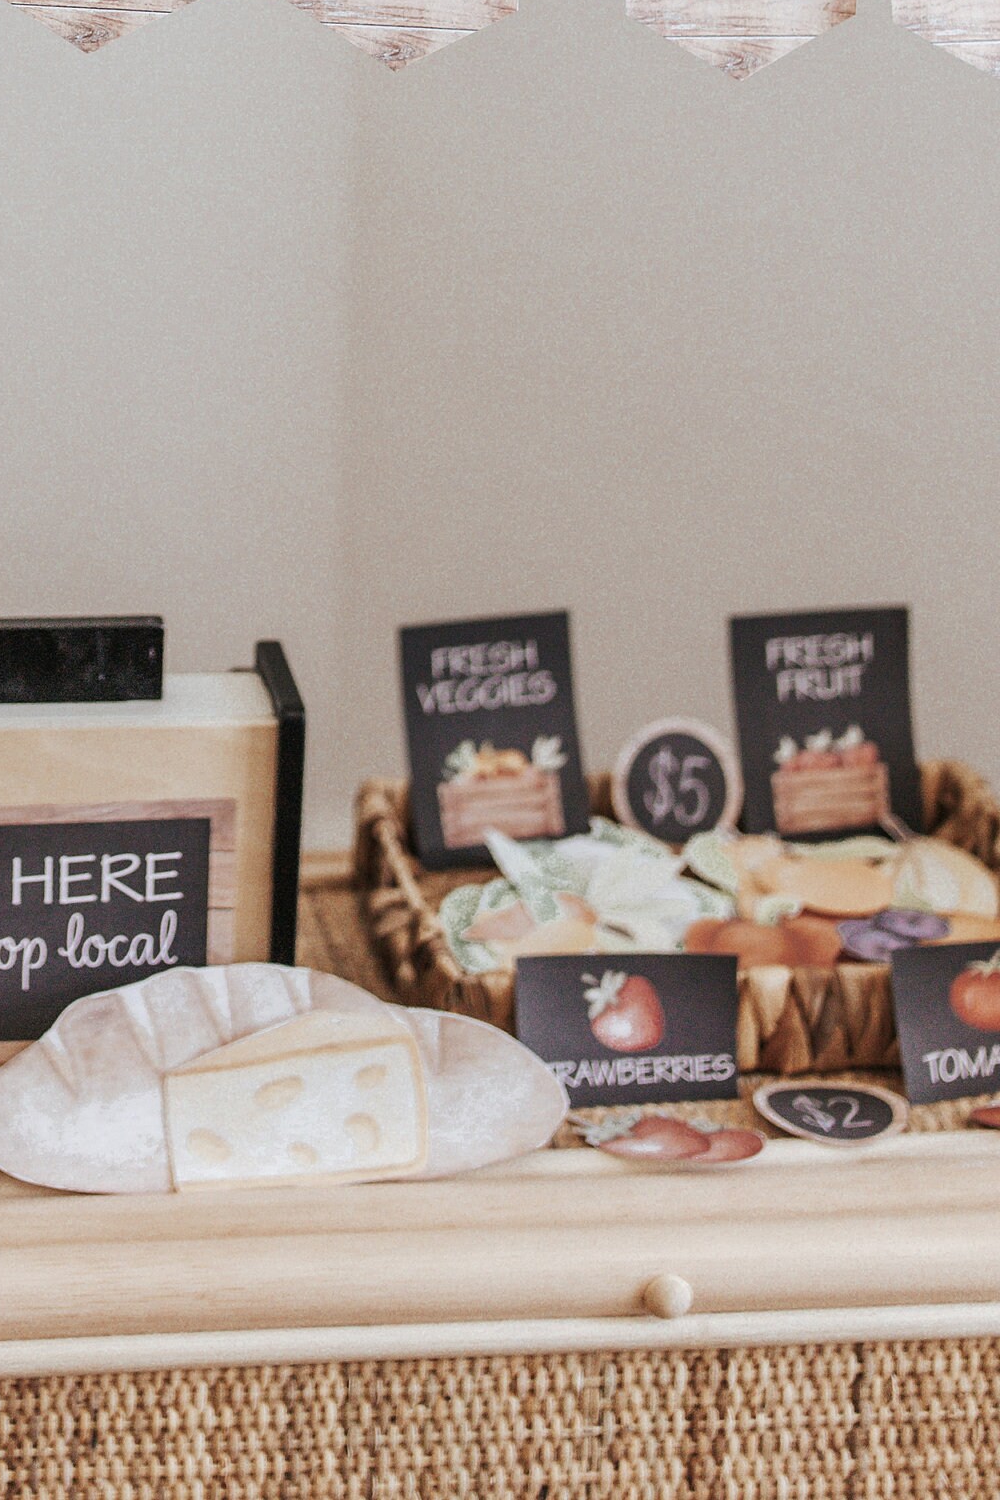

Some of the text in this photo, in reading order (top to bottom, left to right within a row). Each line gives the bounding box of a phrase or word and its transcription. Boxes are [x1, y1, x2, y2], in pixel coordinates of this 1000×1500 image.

[430, 640, 540, 682] FRESH
[765, 632, 875, 672] FRESH
[415, 669, 558, 714] VEGGIES
[776, 662, 864, 702] FRUIT
[643, 743, 712, 828] $5
[11, 850, 184, 906] HERE
[56, 909, 180, 969] local
[791, 1094, 875, 1133] $2
